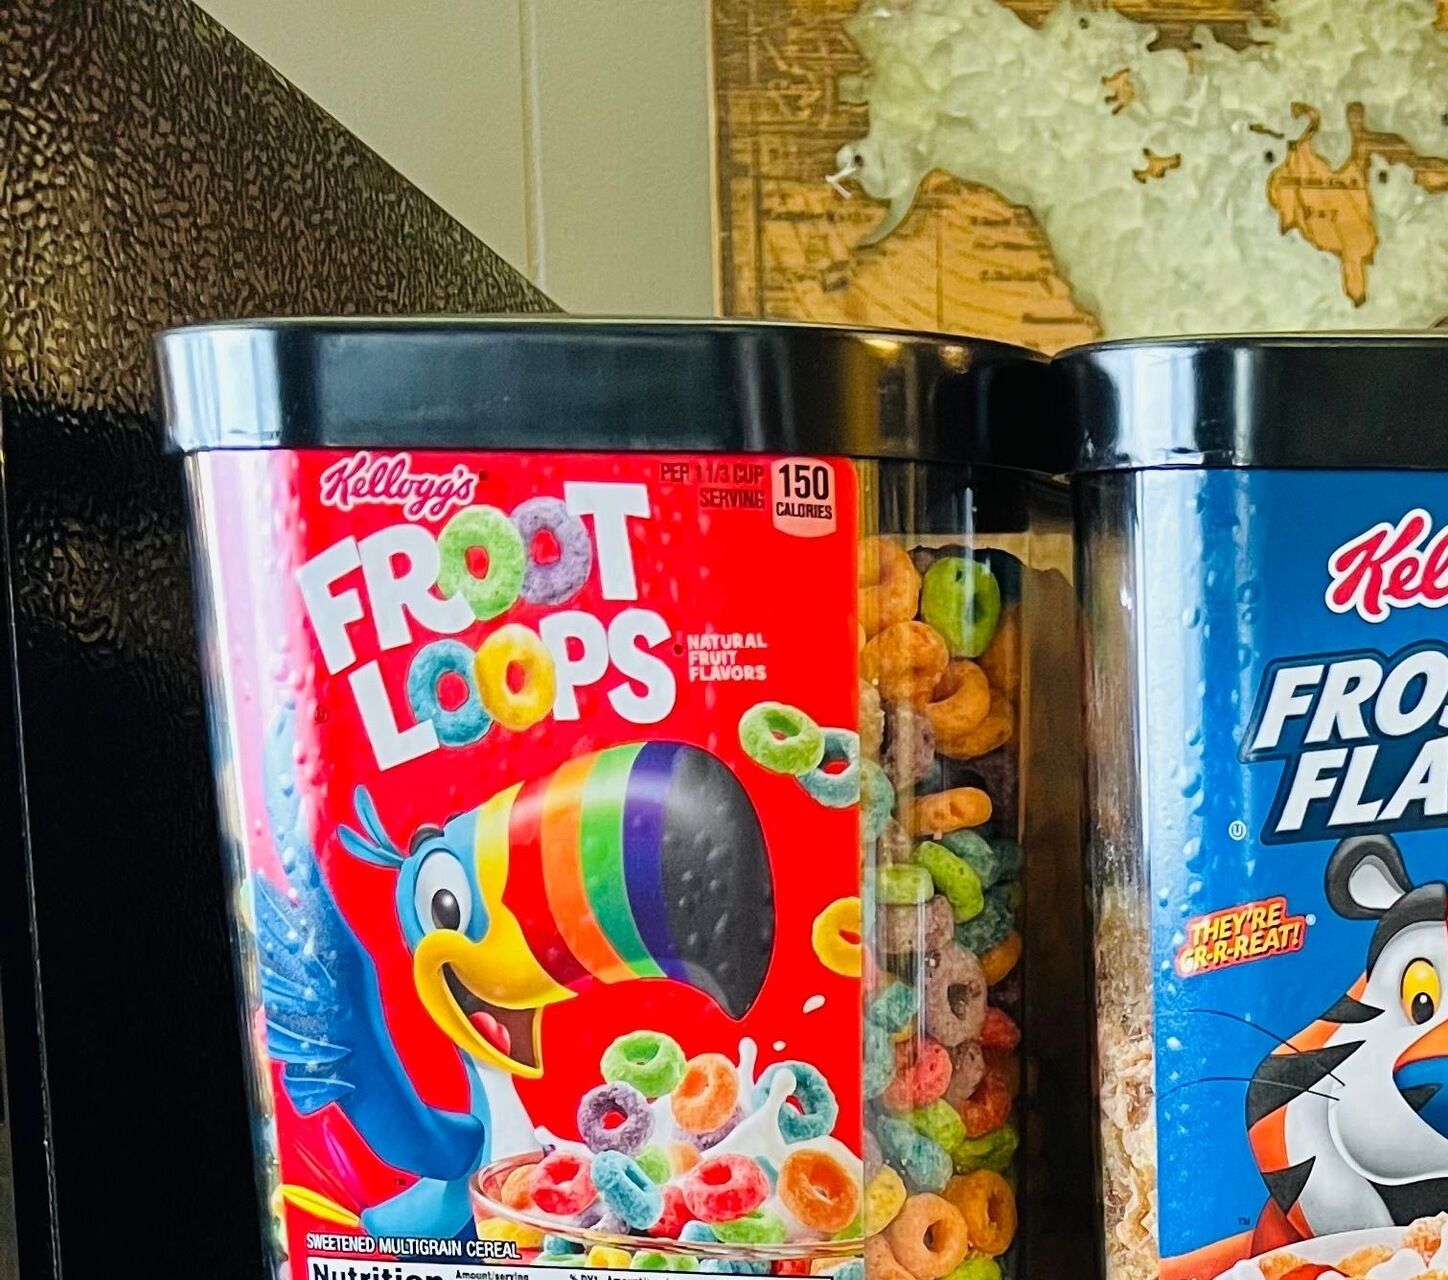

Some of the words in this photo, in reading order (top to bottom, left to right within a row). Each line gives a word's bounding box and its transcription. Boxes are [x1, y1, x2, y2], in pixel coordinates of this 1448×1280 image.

[660, 463, 690, 482] PER
[733, 464, 765, 484] CUP
[779, 464, 829, 500] 150
[322, 453, 477, 519] Kellogg's
[700, 488, 765, 508] SERVING
[776, 501, 832, 520] CALORIES
[295, 480, 651, 676] FROOT
[686, 632, 768, 650] NATURAL
[688, 650, 738, 666] FRUIT
[689, 664, 767, 683] FLAVORS
[348, 608, 677, 771] LOOPS
[1191, 902, 1283, 946] THEY'RE
[1179, 921, 1302, 974] GR-R-REAT!
[306, 1235, 376, 1254] SWEETENED
[379, 1238, 463, 1256] MULTIGRAIN
[466, 1241, 521, 1259] CEREAL
